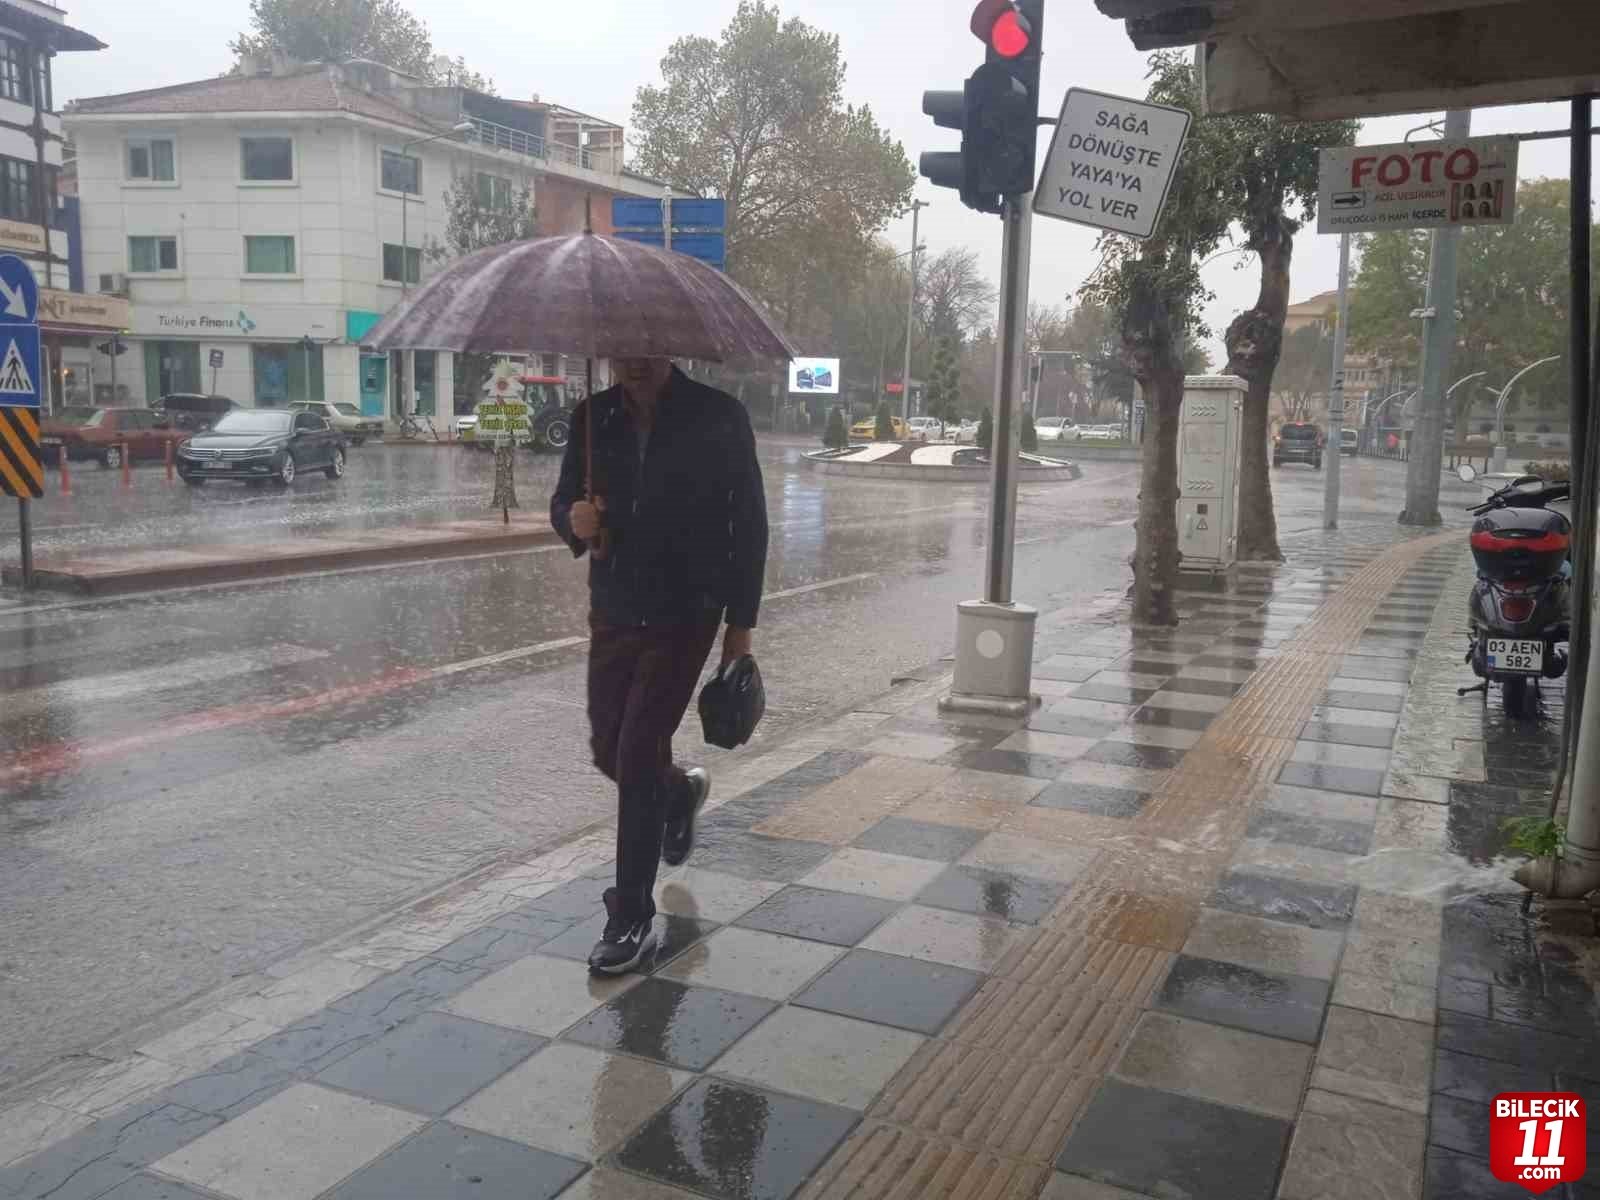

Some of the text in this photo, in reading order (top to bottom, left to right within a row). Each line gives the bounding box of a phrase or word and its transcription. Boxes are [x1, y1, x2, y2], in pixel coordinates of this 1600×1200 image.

[1095, 111, 1149, 135] SAĞA
[1068, 133, 1162, 168] DÖNÜŞTE
[1070, 160, 1142, 192] YAYA'YA
[1351, 148, 1479, 188] FOTO
[1058, 186, 1139, 220] YOL VER
[159, 312, 197, 328] Türkiye
[1489, 641, 1541, 655] 03 AEN
[1505, 655, 1532, 668] 582
